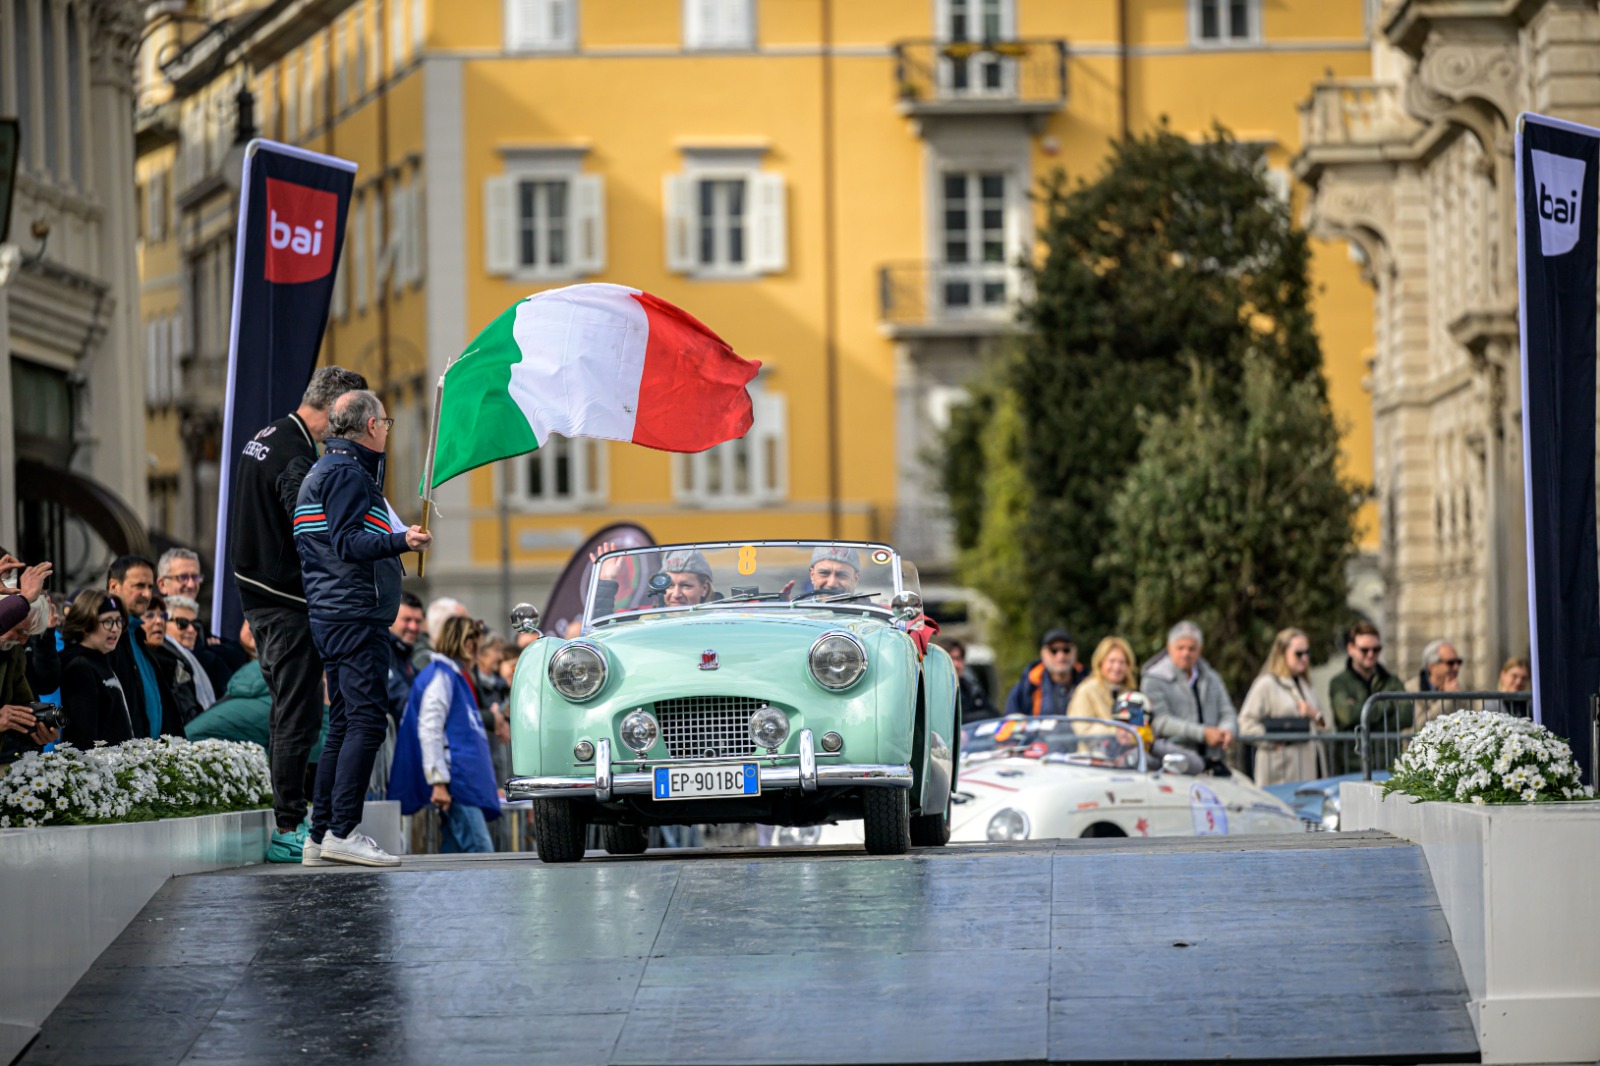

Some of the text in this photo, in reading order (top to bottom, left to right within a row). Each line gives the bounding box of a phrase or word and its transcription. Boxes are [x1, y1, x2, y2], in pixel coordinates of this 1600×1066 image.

[1539, 181, 1578, 225] bai
[270, 208, 324, 257] bai
[737, 545, 757, 576] 8
